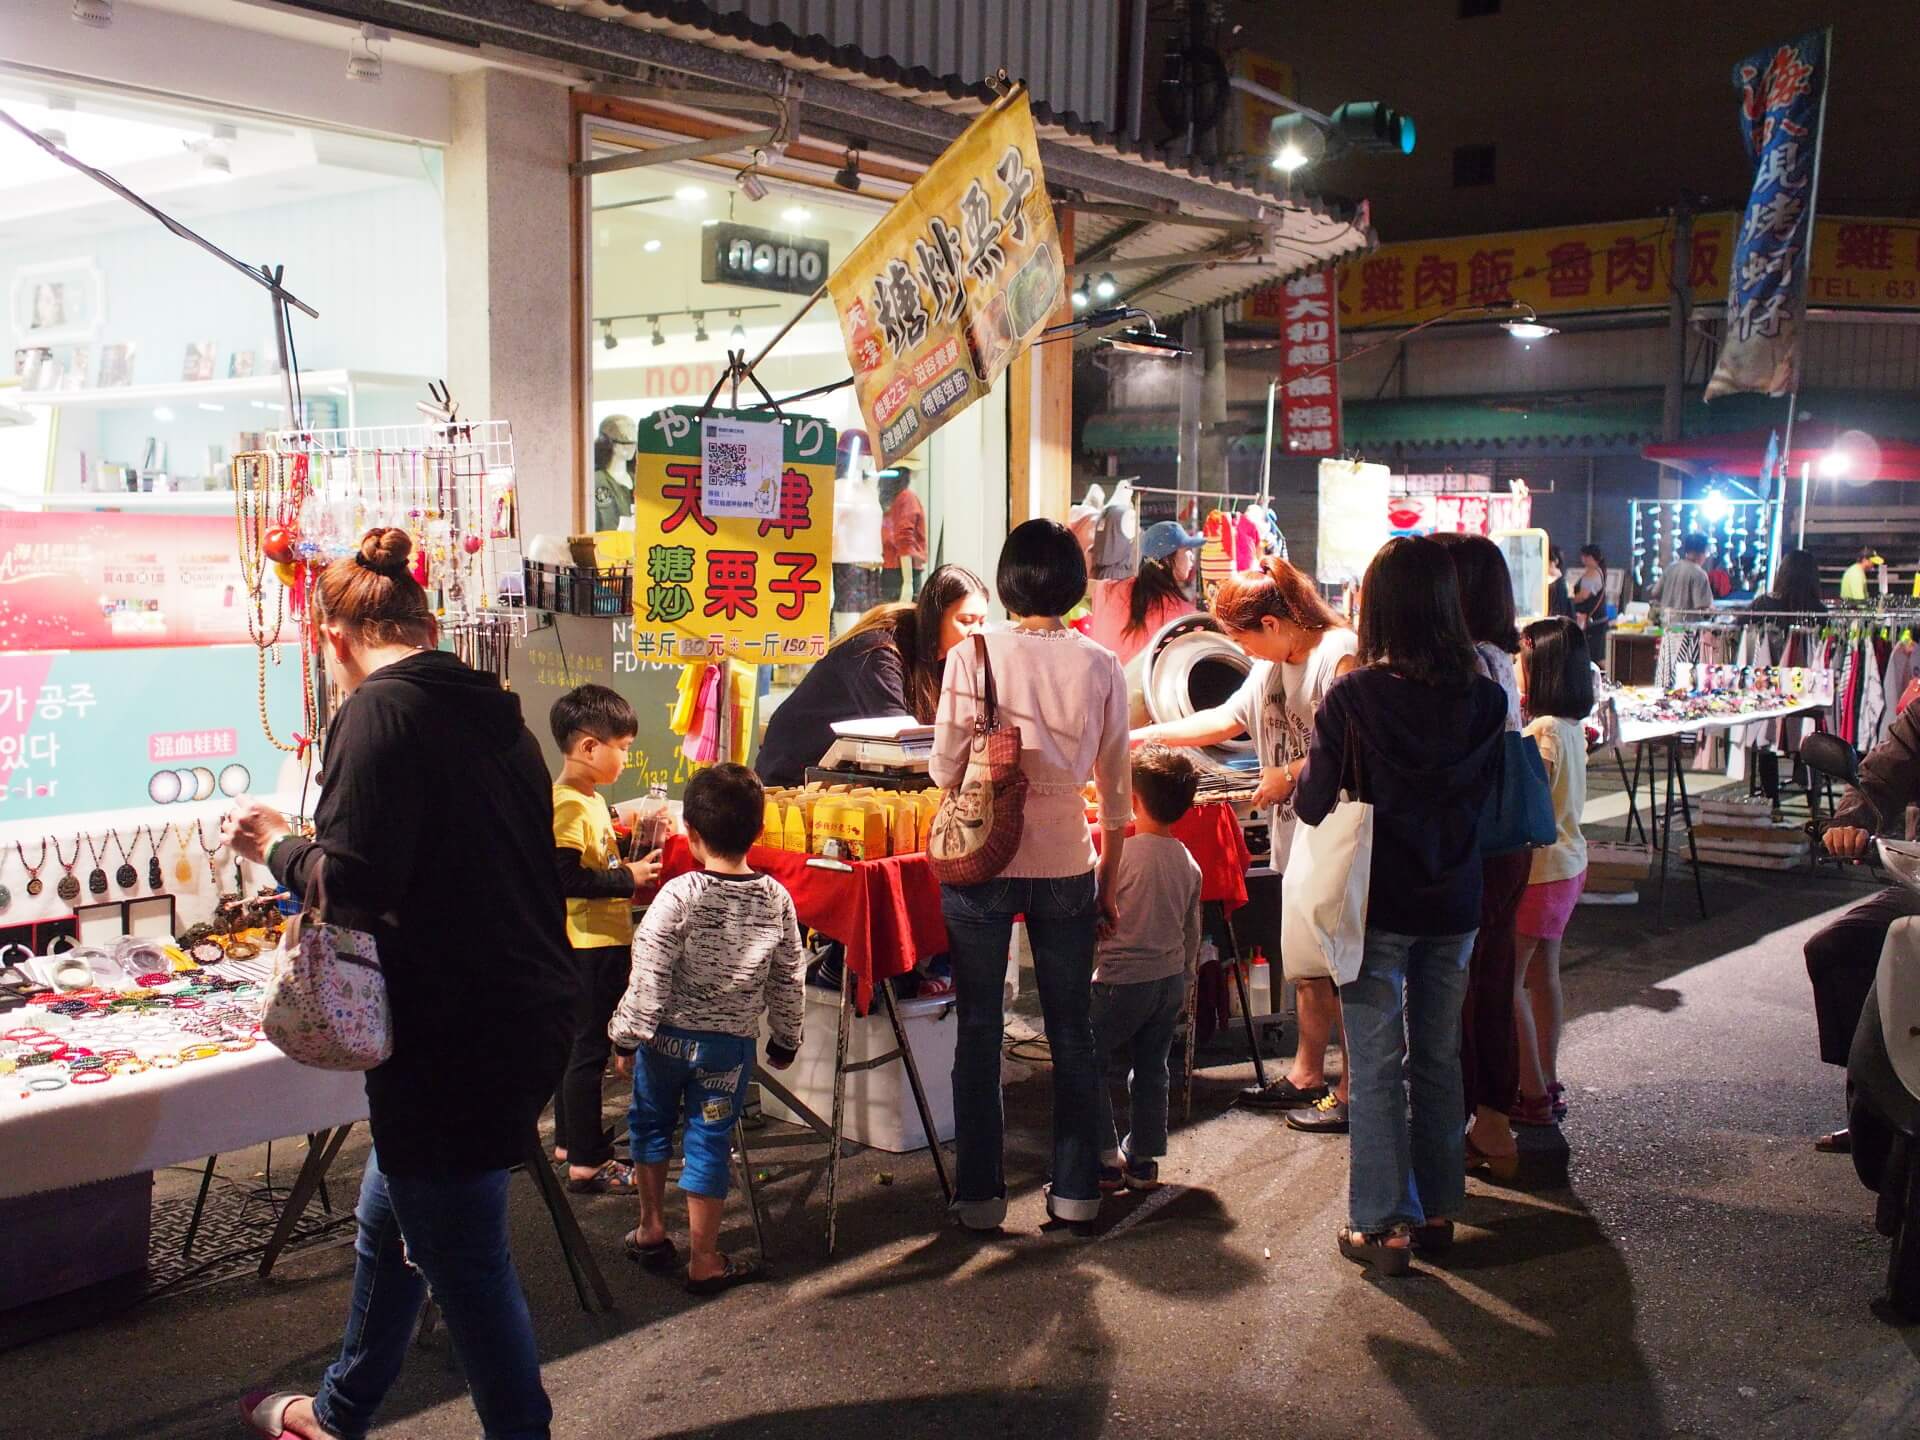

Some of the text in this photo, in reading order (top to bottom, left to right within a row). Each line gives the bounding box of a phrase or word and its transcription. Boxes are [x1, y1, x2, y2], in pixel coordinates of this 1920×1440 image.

[728, 238, 822, 281] nono
[645, 362, 734, 396] non
[646, 545, 694, 622] 糖炒
[703, 550, 821, 620] 栗子
[36, 682, 96, 720] 공주
[154, 733, 233, 757] 混血娃娃
